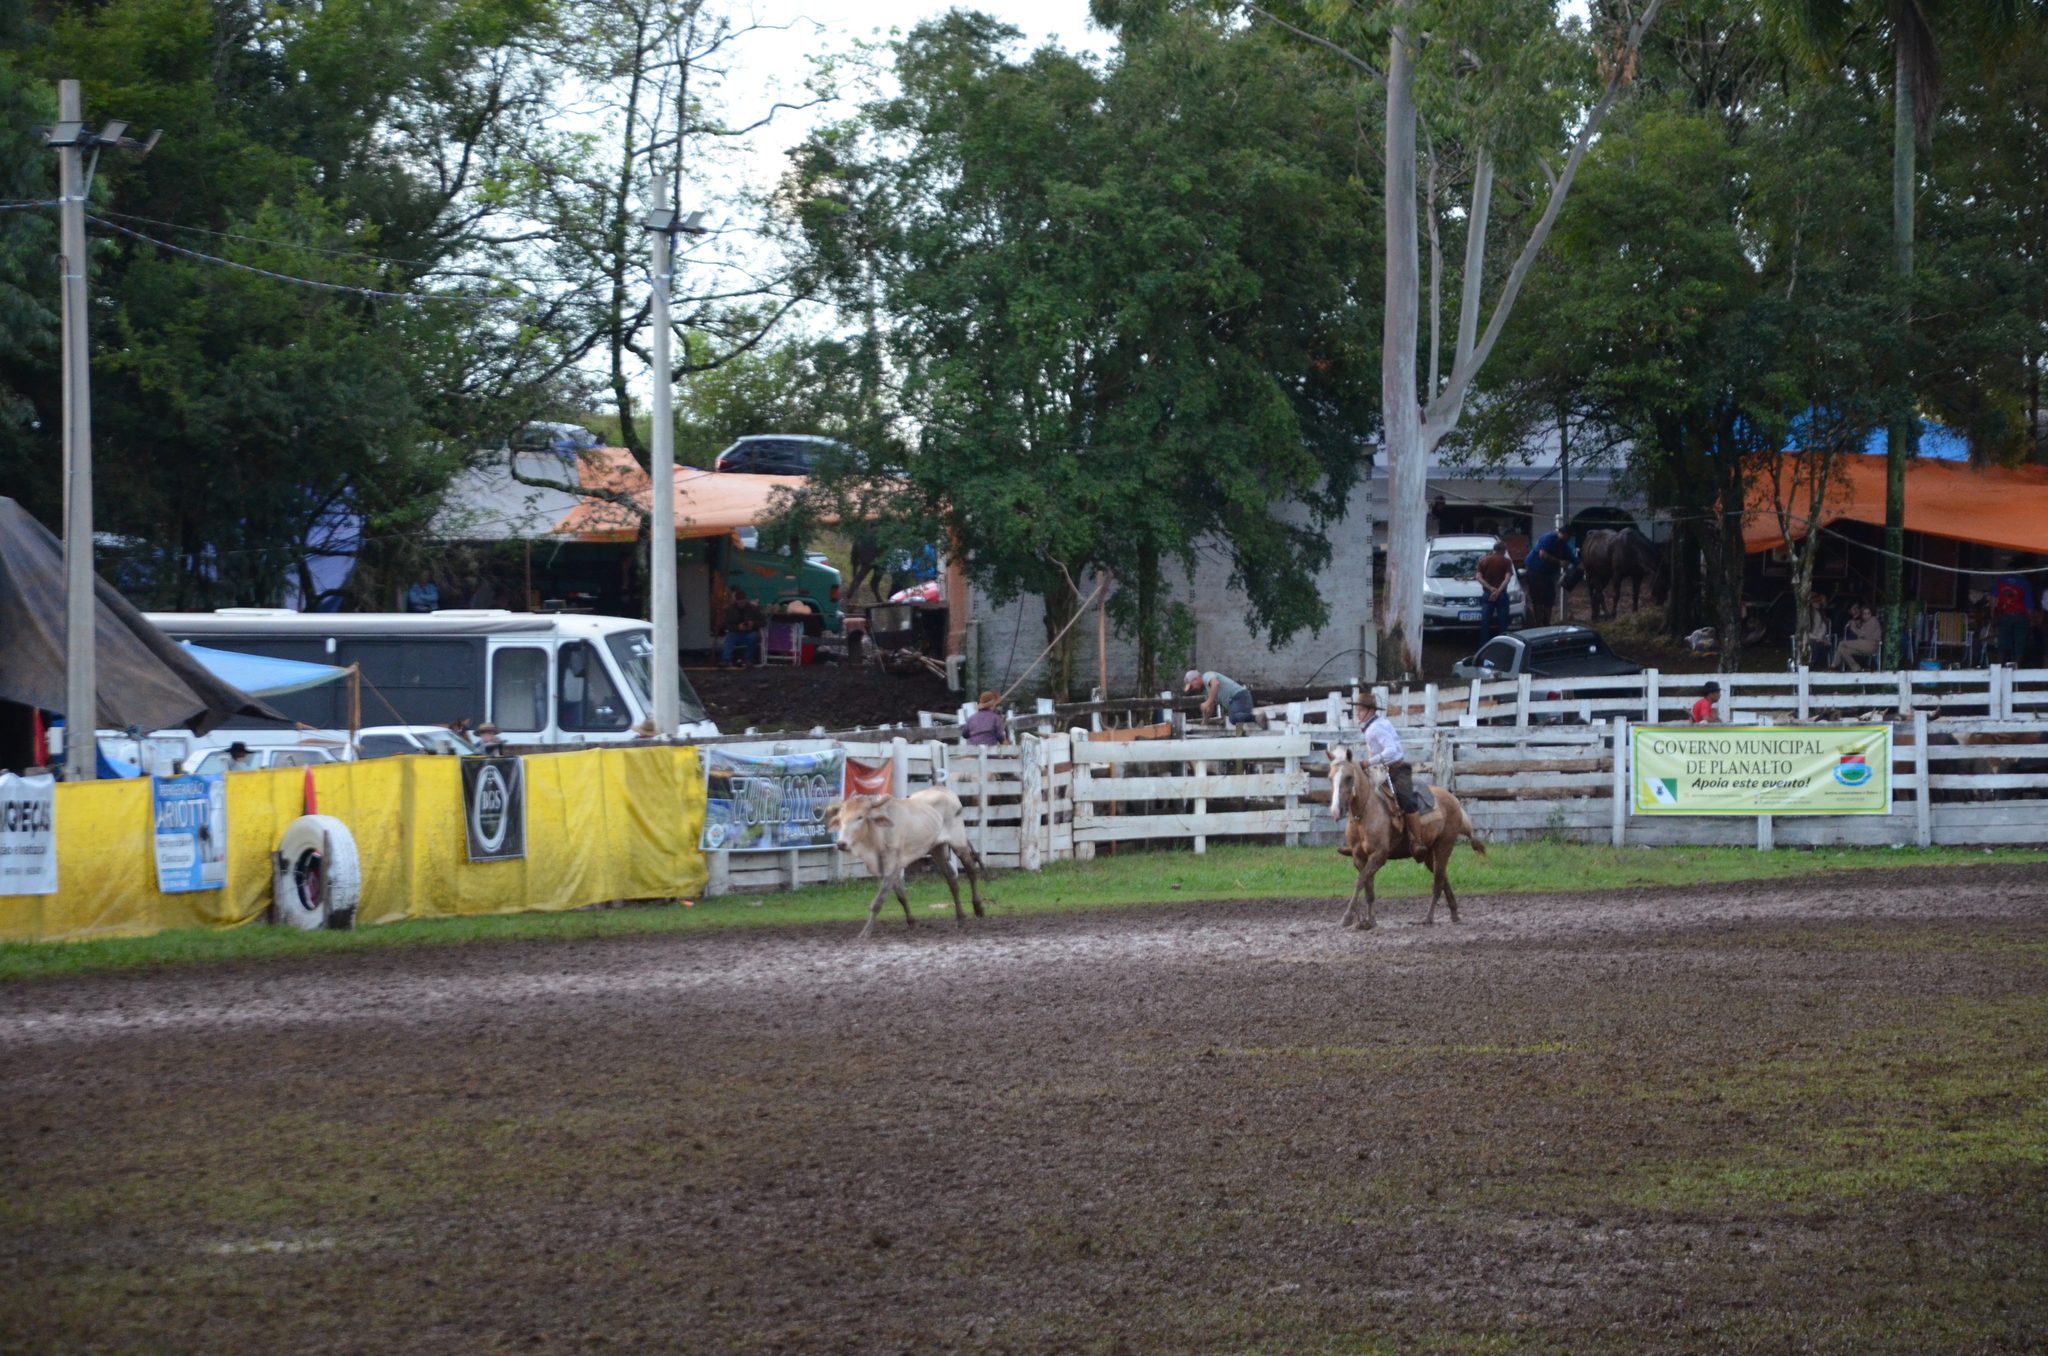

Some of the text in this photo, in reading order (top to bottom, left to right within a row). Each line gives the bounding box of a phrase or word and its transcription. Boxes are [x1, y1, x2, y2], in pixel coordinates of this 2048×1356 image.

[1653, 739, 1824, 755] GOVERNO MUNICIPAL
[1686, 759, 1793, 775] DE PLANALTO
[1691, 777, 1811, 790] Apoia este evento!
